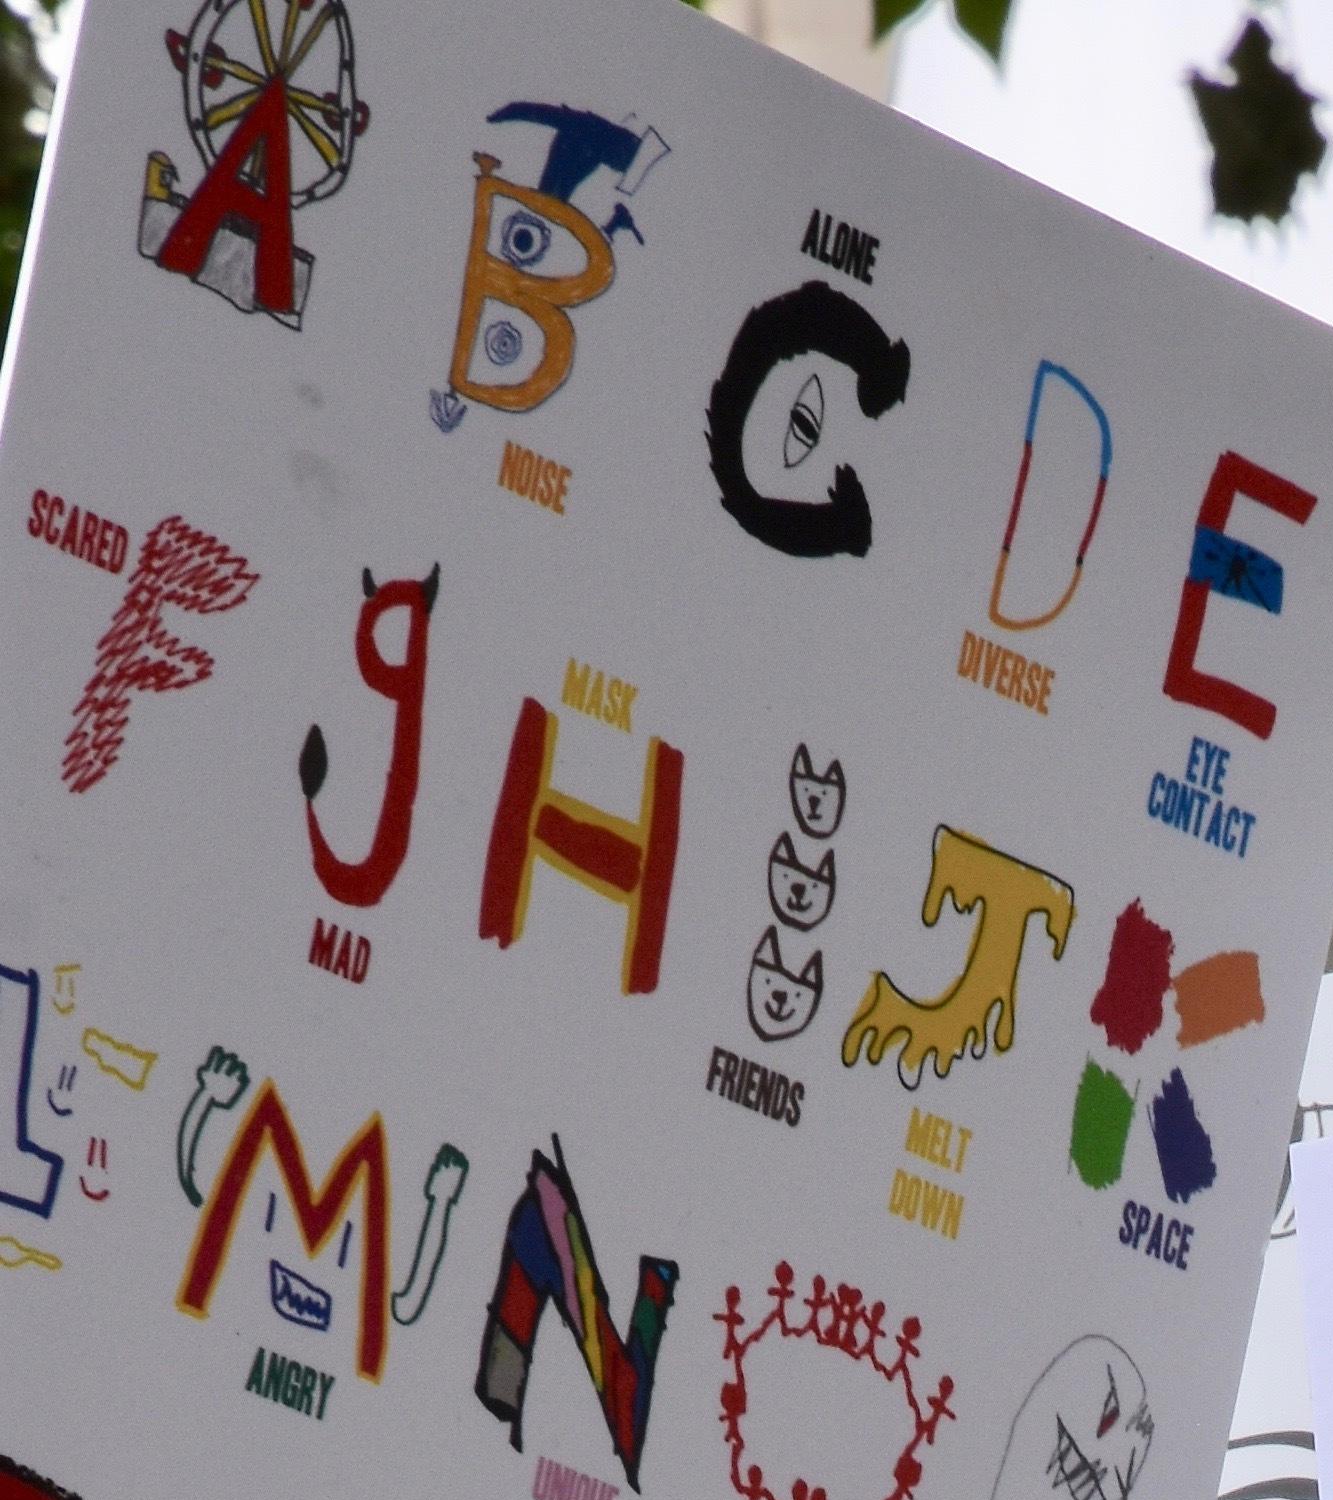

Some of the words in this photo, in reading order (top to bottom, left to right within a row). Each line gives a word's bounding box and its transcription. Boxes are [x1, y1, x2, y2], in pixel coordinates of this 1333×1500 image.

[800, 208, 880, 286] ALONE
[498, 439, 572, 516] NOISE
[989, 359, 1113, 632] D
[26, 488, 128, 575] SCARED
[1162, 450, 1319, 741] E
[560, 656, 638, 735] MASK
[956, 630, 1055, 717] DIVERSE
[1185, 735, 1230, 797] EYE
[1147, 771, 1255, 860] CONTACT
[308, 917, 372, 985] MAD
[705, 1045, 805, 1129] FRIENDS
[903, 1106, 973, 1174] MELT
[887, 1168, 965, 1241] DOWN
[1118, 1200, 1194, 1271] SPACE
[245, 1347, 336, 1420] ANGRY
